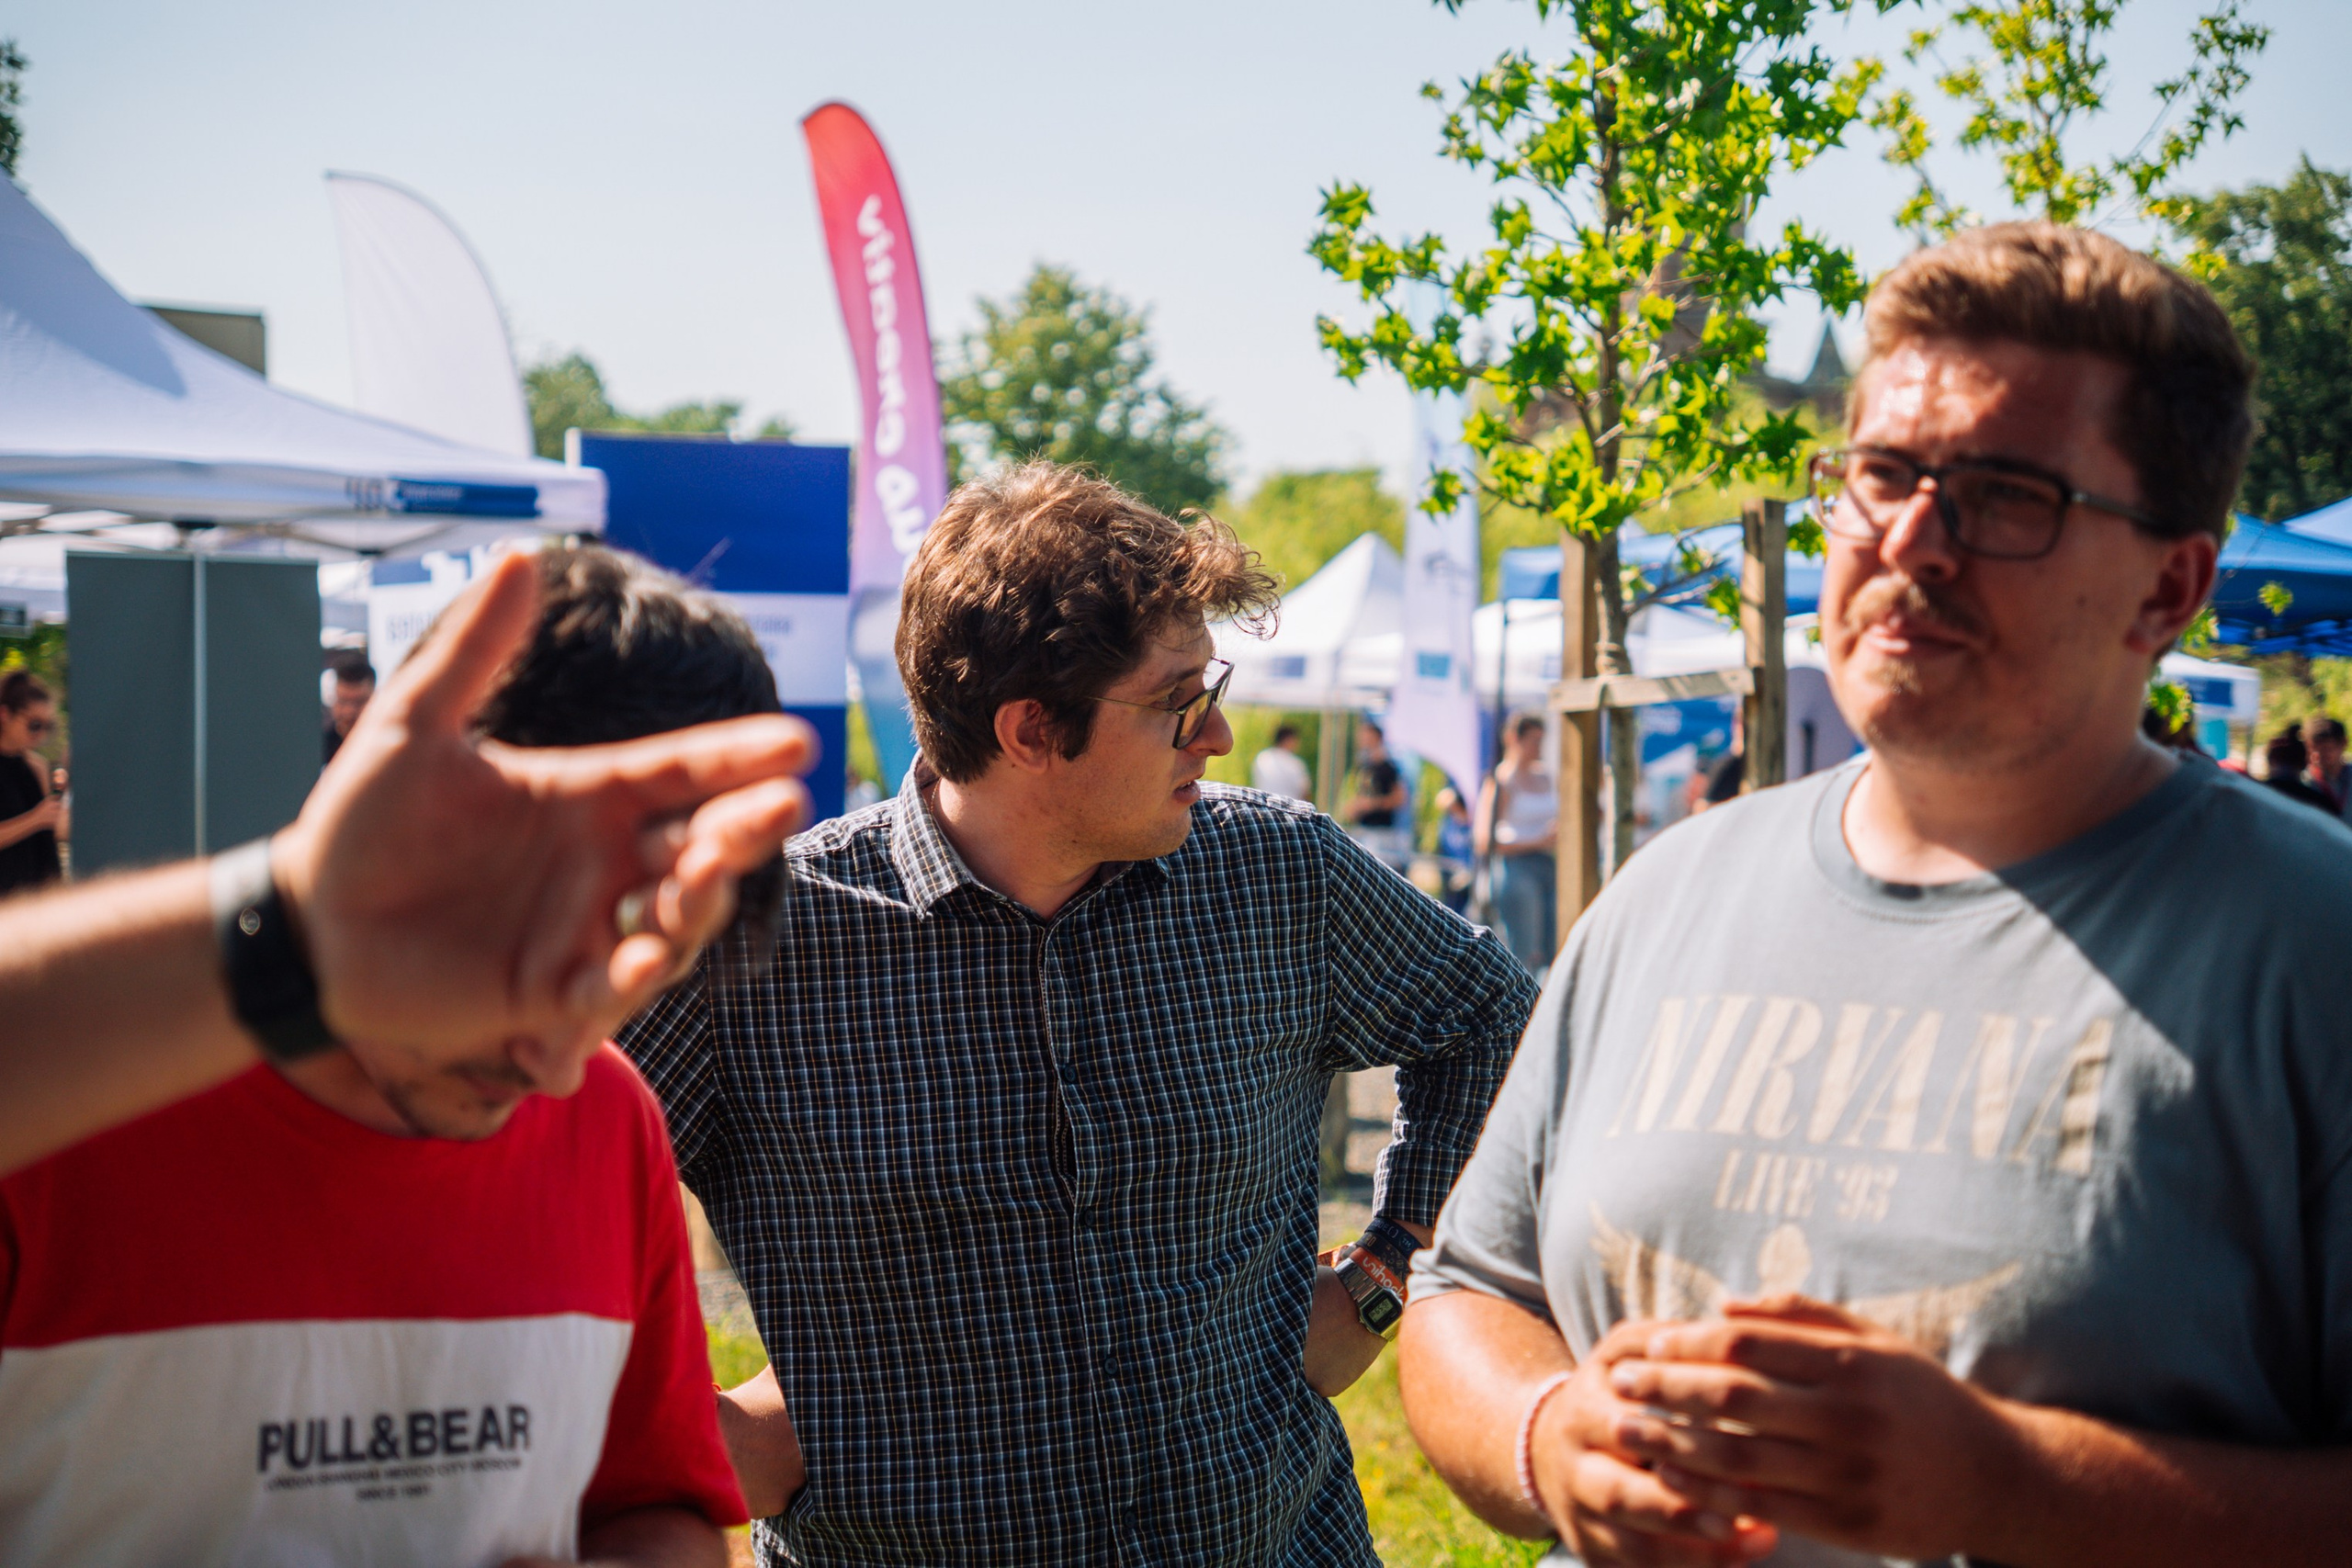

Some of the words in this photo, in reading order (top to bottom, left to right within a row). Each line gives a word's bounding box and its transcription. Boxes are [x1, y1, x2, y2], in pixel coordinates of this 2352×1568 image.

[1605, 994, 2114, 1179] NIRVANA
[1713, 1149, 1826, 1219] LIVE
[256, 1404, 531, 1473] PULL&BEAR
